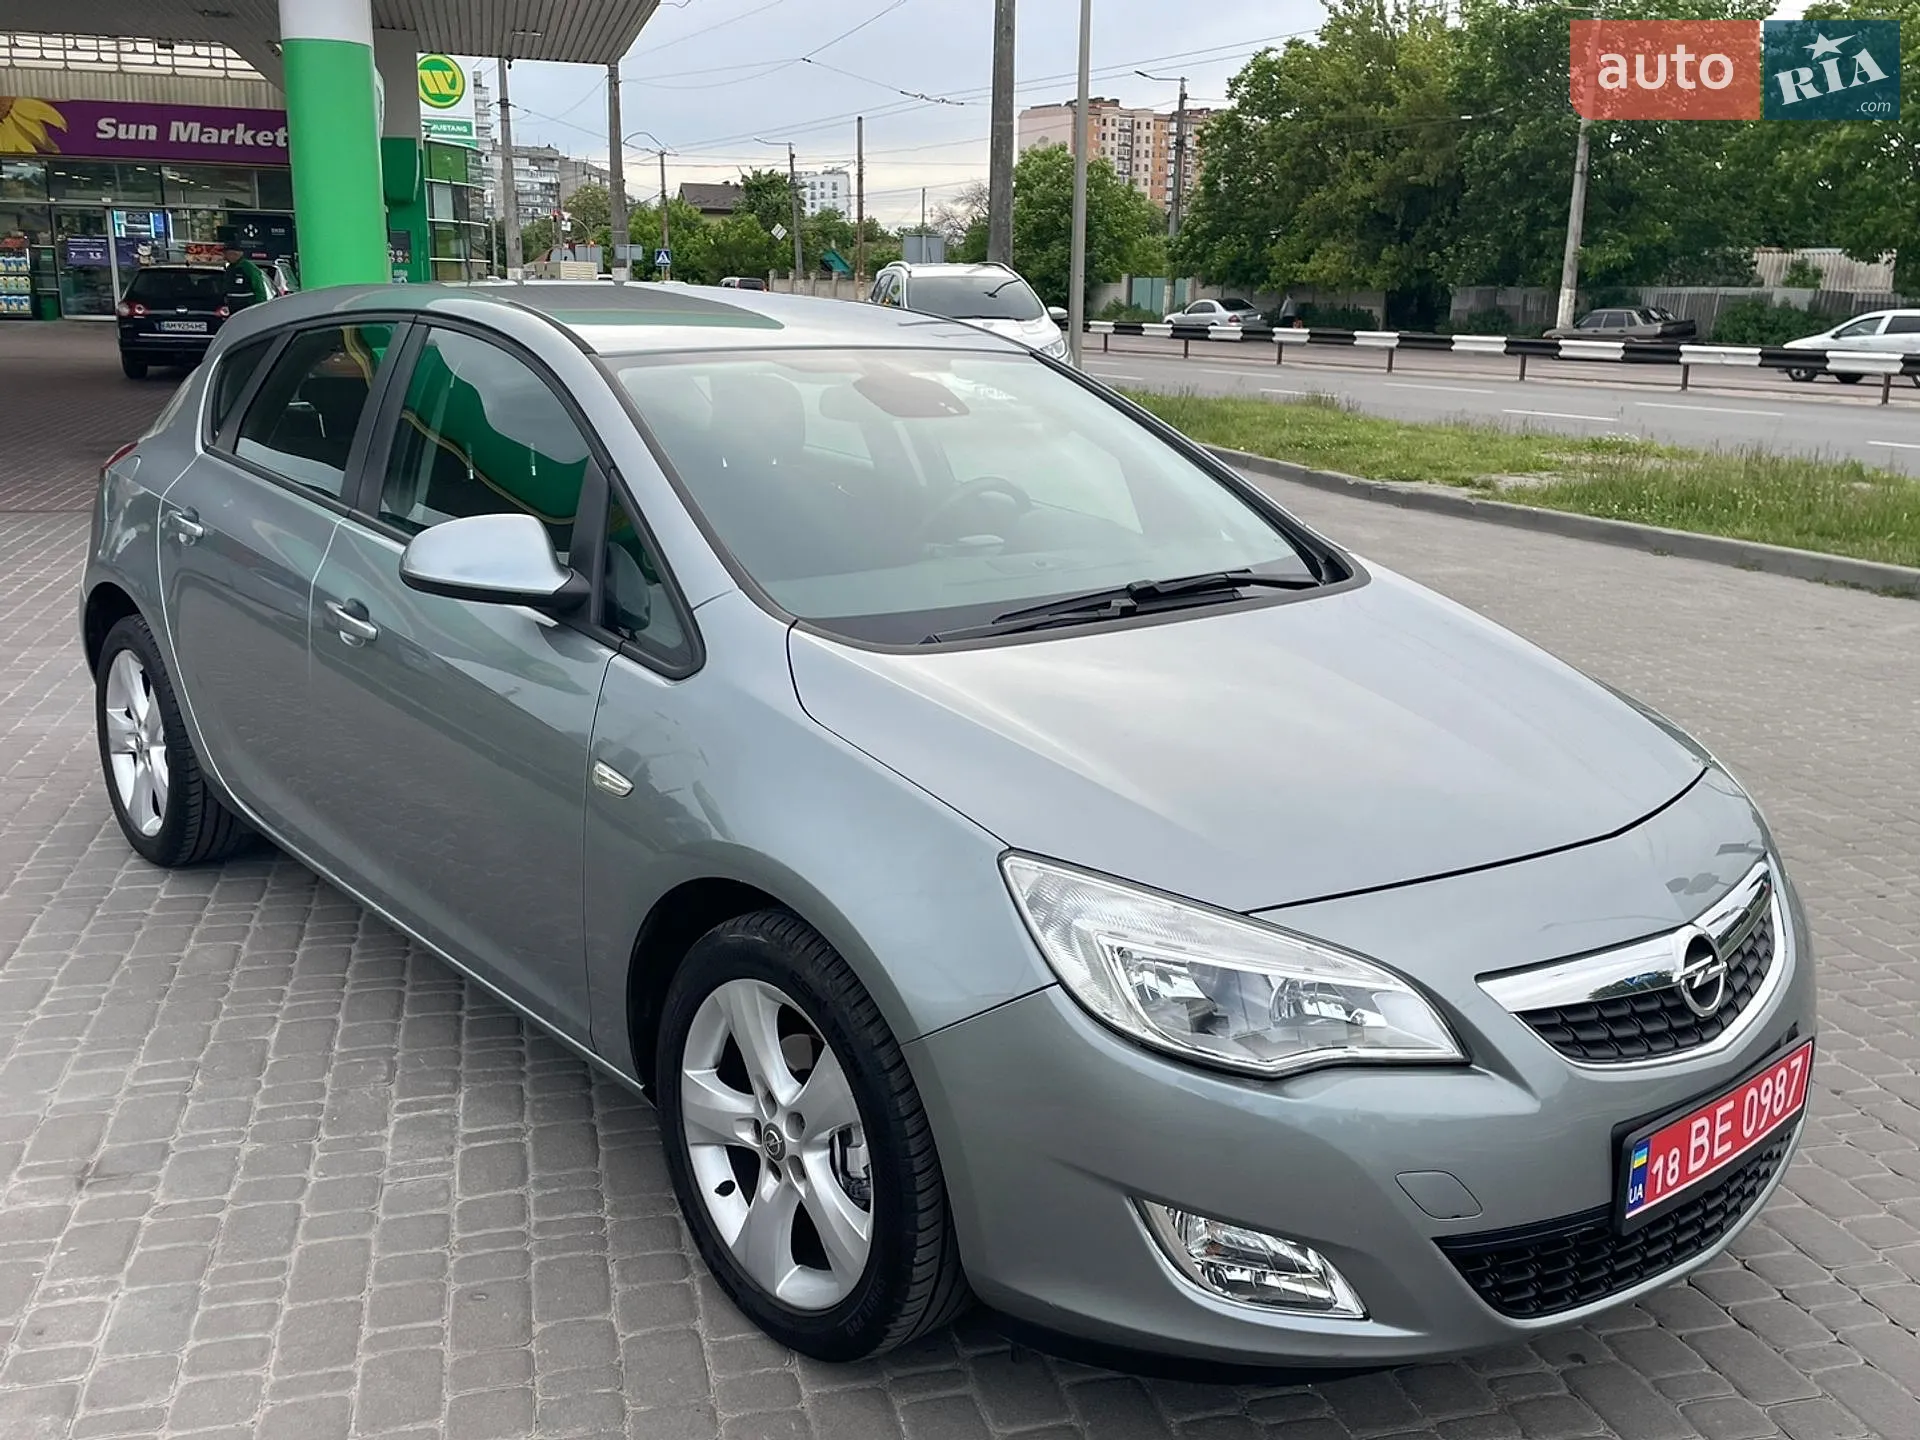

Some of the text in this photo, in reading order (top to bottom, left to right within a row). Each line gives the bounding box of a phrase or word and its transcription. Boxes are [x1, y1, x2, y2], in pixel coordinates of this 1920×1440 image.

[96, 117, 289, 148] Sun Market
[1651, 1054, 1803, 1195] 18 BE 0987
[1629, 1183, 1644, 1204] UA
